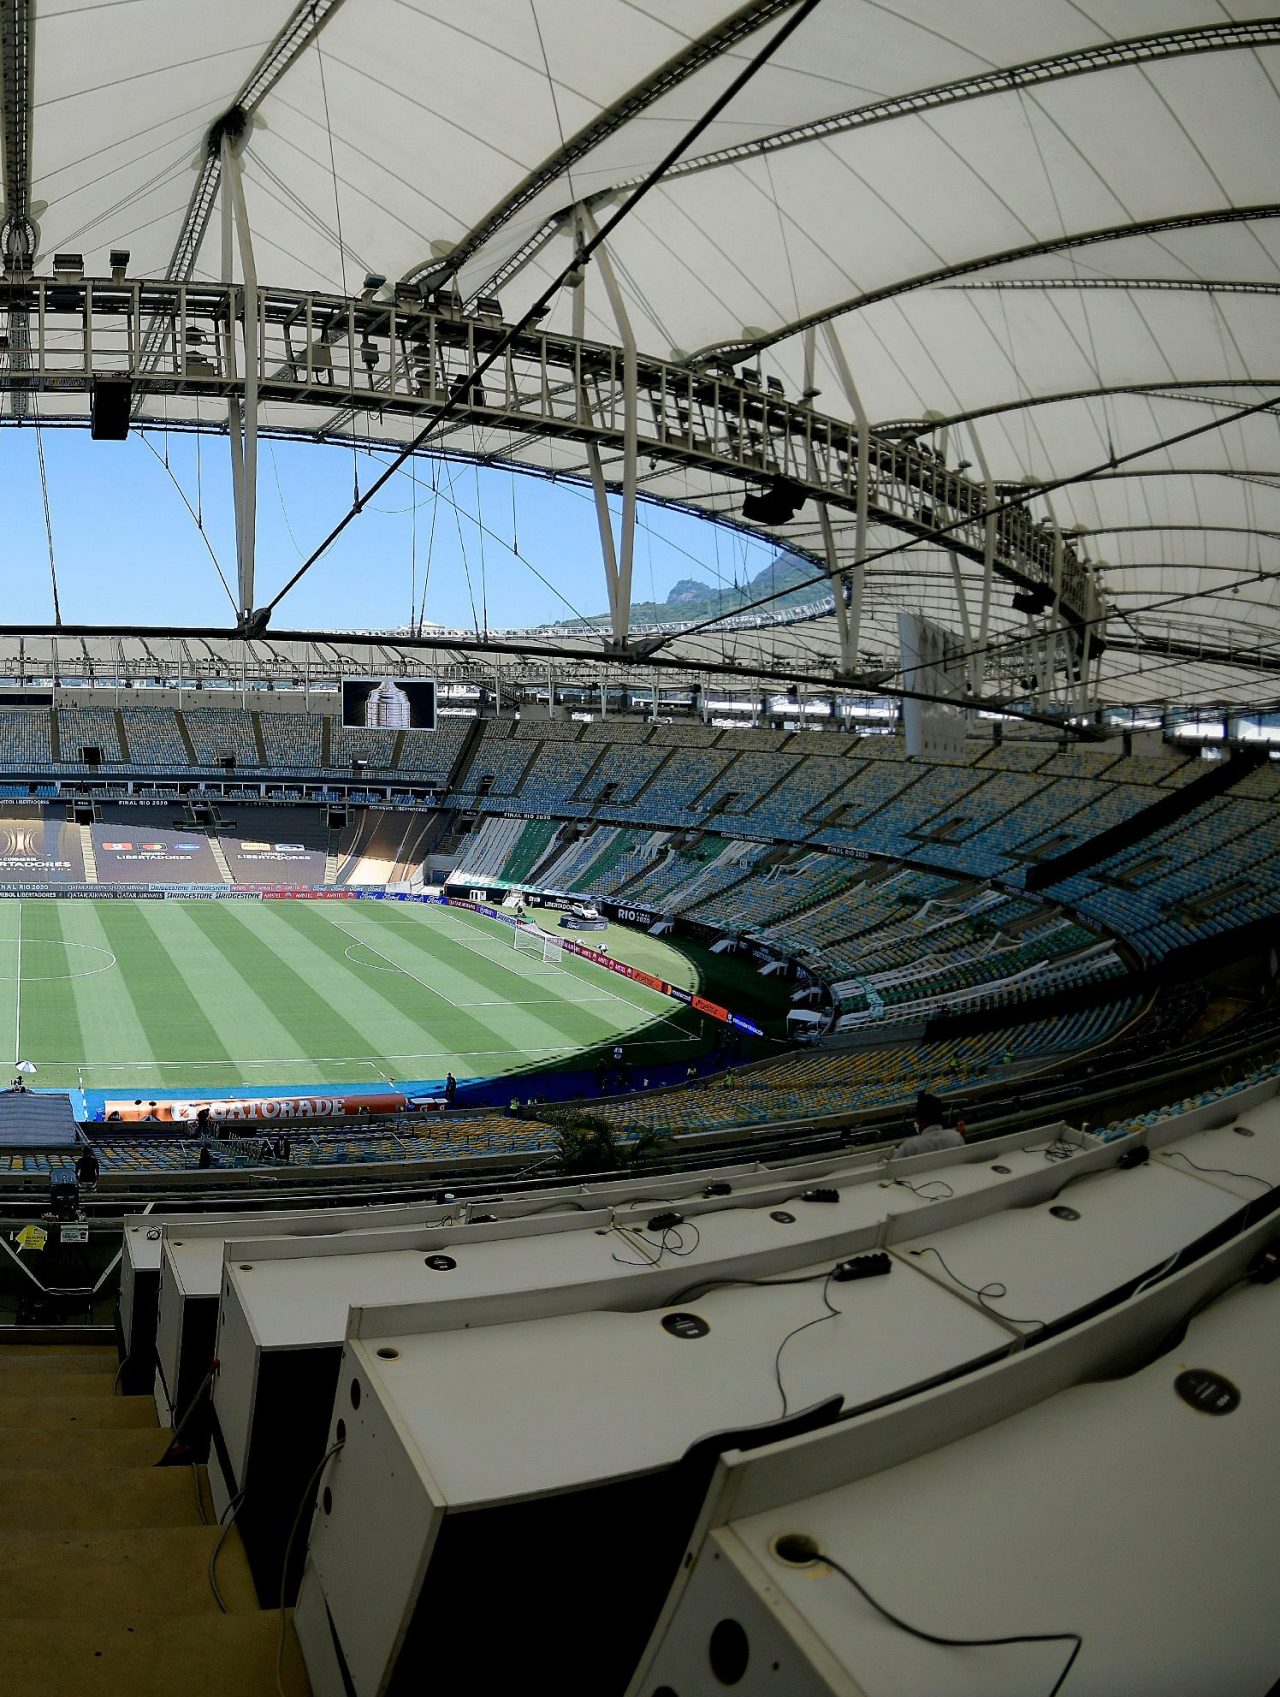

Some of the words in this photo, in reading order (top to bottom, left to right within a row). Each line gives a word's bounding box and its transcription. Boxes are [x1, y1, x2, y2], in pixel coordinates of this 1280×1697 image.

[827, 846, 844, 854] FINAL
[426, 896, 443, 904] Ford
[618, 908, 636, 921] RIO
[636, 915, 650, 924] 2020
[209, 1098, 346, 1120] GATORADE
